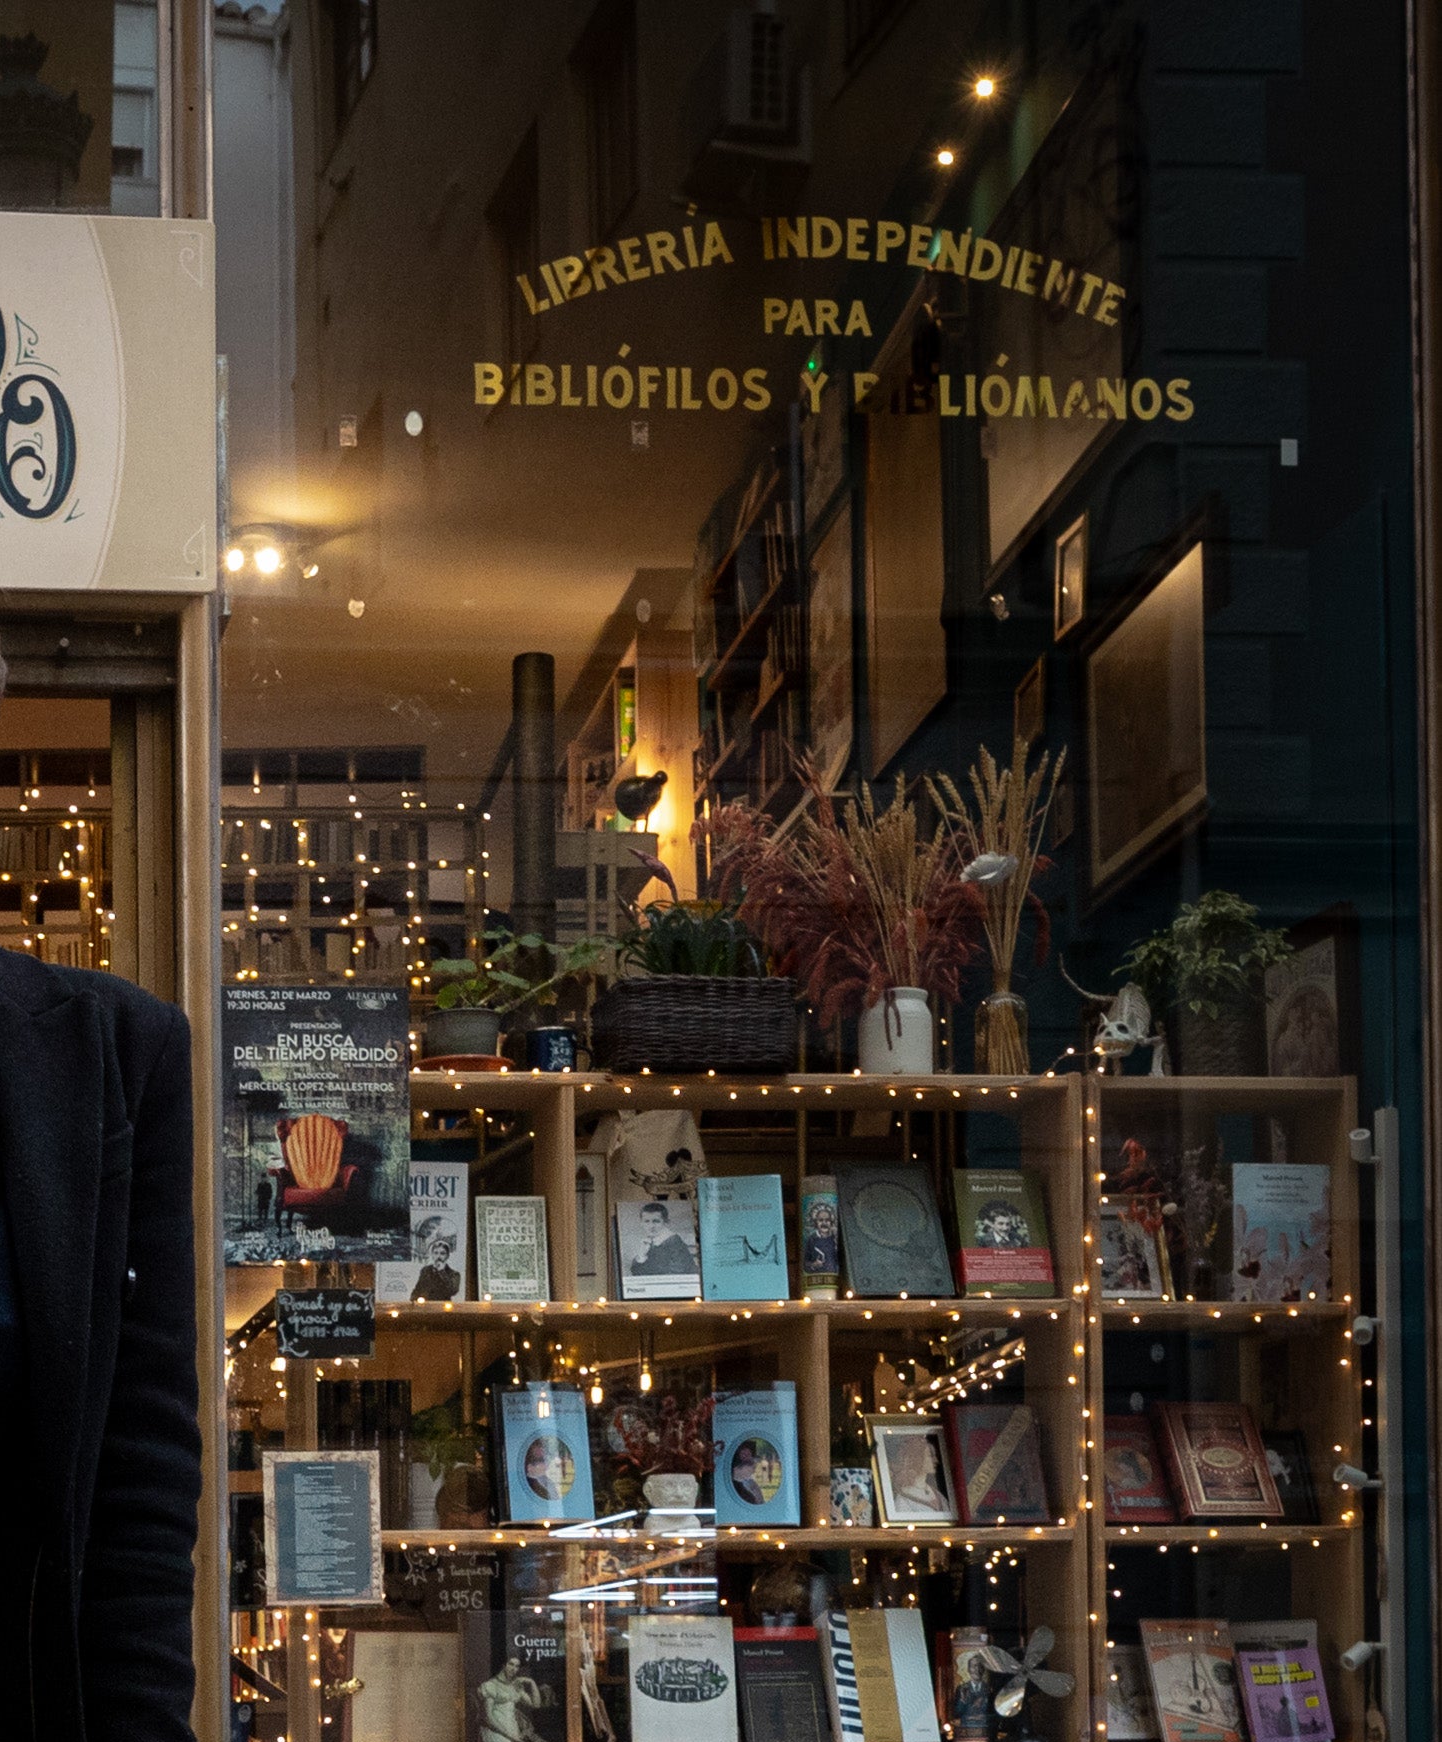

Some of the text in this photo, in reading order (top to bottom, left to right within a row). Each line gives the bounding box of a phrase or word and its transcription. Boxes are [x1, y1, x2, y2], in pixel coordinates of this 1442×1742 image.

[515, 202, 1127, 328] LIBRERÍA INDEPENDIENTE
[763, 295, 873, 338] PARA
[472, 344, 773, 412] BIBLIÓFILOS
[799, 372, 830, 415] Y
[227, 990, 332, 1001] VIERNES, 21 DE MARZO
[345, 992, 398, 1001] ALFAGUARA
[227, 1001, 286, 1011] 19:30 HORAS
[290, 1021, 342, 1030] PRESENTACIÓN
[277, 1034, 355, 1048] EN BUSCA
[234, 1047, 398, 1062] DEL TIEMPO PERDIDO
[239, 1081, 290, 1091] MERCEDES
[279, 1293, 324, 1311] Proust
[514, 1634, 557, 1648] Guerra
[525, 1649, 558, 1660] y paz
